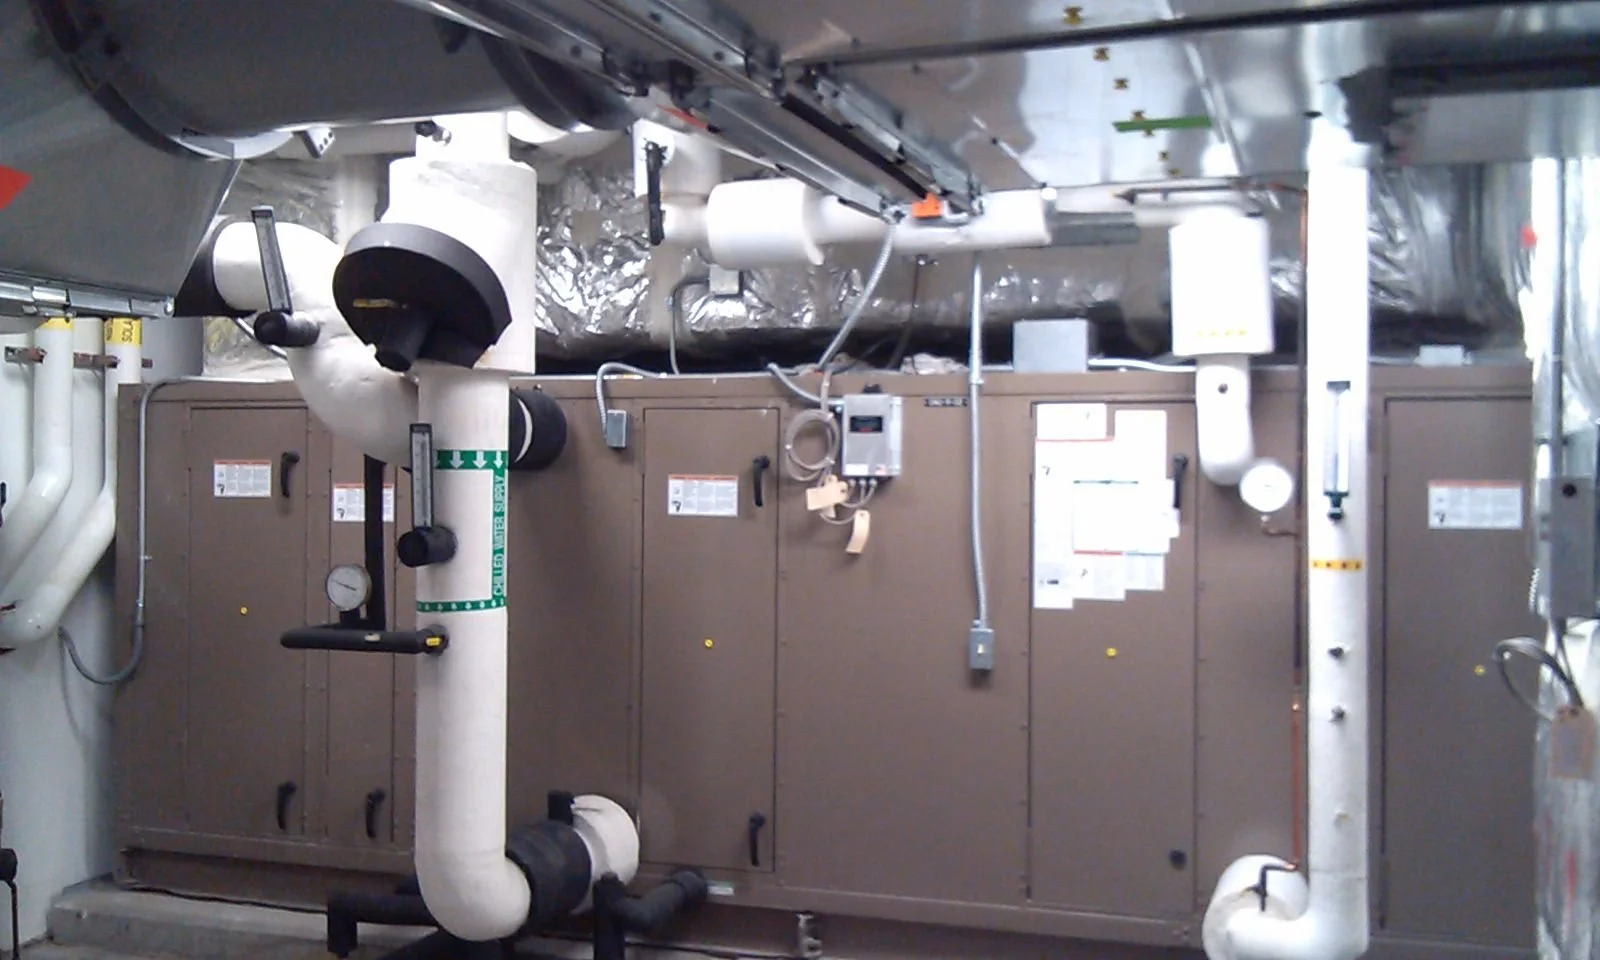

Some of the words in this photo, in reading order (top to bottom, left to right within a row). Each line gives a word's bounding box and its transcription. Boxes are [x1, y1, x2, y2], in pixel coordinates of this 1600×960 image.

[493, 475, 505, 513] SUPPLY
[493, 516, 505, 551] WATER
[493, 553, 505, 597] CHILLED
